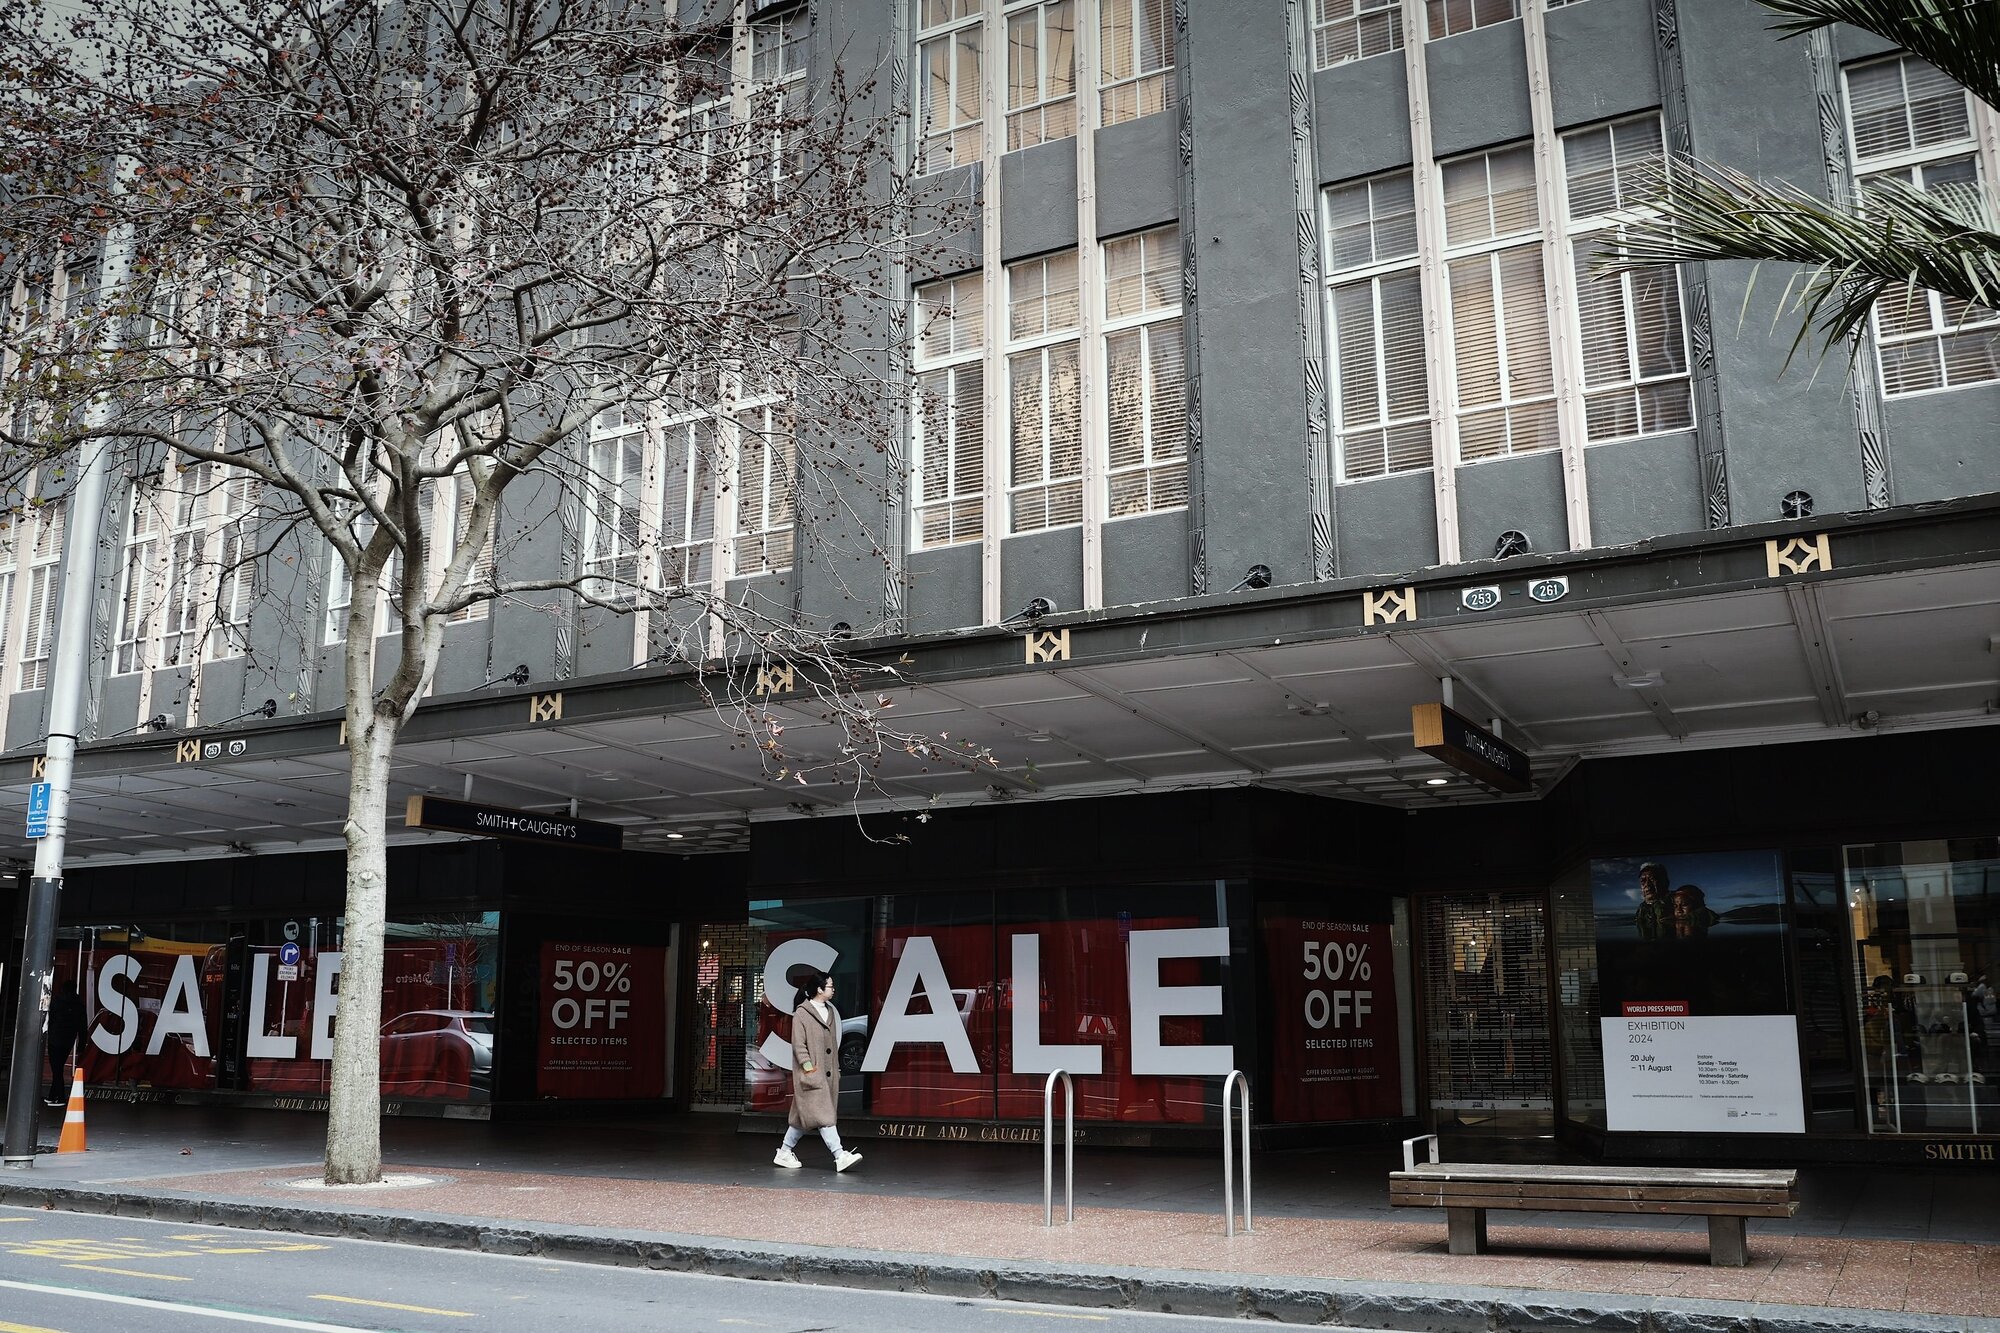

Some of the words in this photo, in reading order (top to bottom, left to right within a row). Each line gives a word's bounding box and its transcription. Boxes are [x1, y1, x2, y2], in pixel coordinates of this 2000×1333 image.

[1539, 583, 1559, 597] 261
[1471, 592, 1492, 605] 253
[208, 746, 218, 755] 253
[36, 785, 45, 798] P
[476, 812, 577, 839] SMITH+CAUGHEY'S
[1302, 921, 1316, 930] END
[1316, 922, 1326, 930] OF
[1326, 922, 1352, 931] SEASON
[1352, 924, 1370, 932] SALE
[555, 944, 570, 952] END
[583, 945, 611, 953] SEASON
[612, 947, 632, 955] SALE
[91, 953, 343, 1060] SALE
[758, 926, 1235, 1076] SALE
[551, 997, 631, 1029] OFF
[1304, 989, 1373, 1029] OFF
[1647, 1005, 1665, 1013] PRESS
[1627, 1020, 1685, 1031] EXHIBITION
[550, 1036, 598, 1045] SELECTED
[600, 1037, 628, 1045] ITEMS
[1305, 1039, 1348, 1049] SELECTED
[1349, 1039, 1374, 1048] ITEMS
[1628, 1033, 1653, 1044] 2024
[1630, 1054, 1640, 1062] 20
[1640, 1054, 1655, 1063] July
[1647, 1064, 1673, 1073] August
[272, 1098, 304, 1110] SMITH
[308, 1100, 329, 1111] AND
[878, 1123, 926, 1137] SMITH
[936, 1125, 968, 1139] AND
[980, 1127, 1045, 1142] CAUGHE
[1924, 1143, 1995, 1160] SMITH
